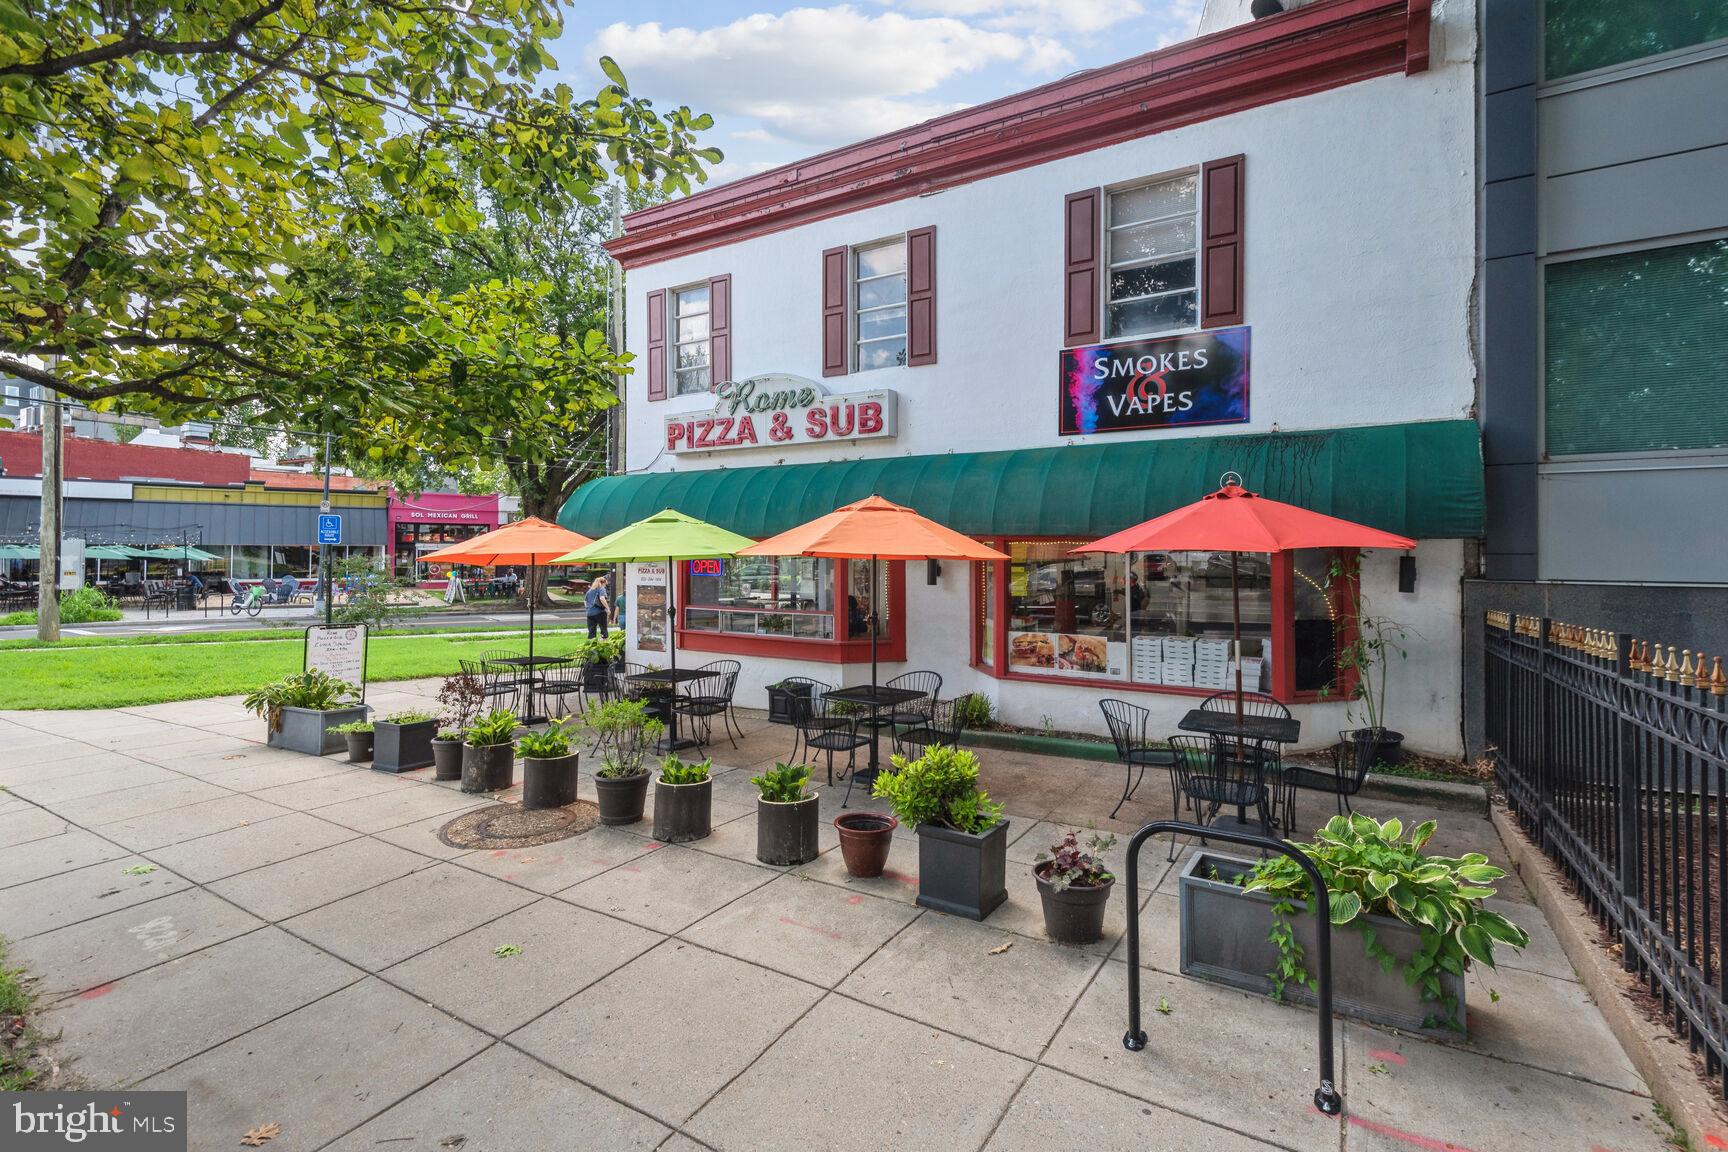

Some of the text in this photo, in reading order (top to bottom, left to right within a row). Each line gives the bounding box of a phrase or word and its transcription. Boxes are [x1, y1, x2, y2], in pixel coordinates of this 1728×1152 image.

[1094, 349, 1208, 380] SMOKES
[715, 379, 815, 415] Rome
[1106, 391, 1193, 417] VAPES
[667, 402, 884, 450] PIZZA & SUB
[693, 560, 720, 574] OPEN
